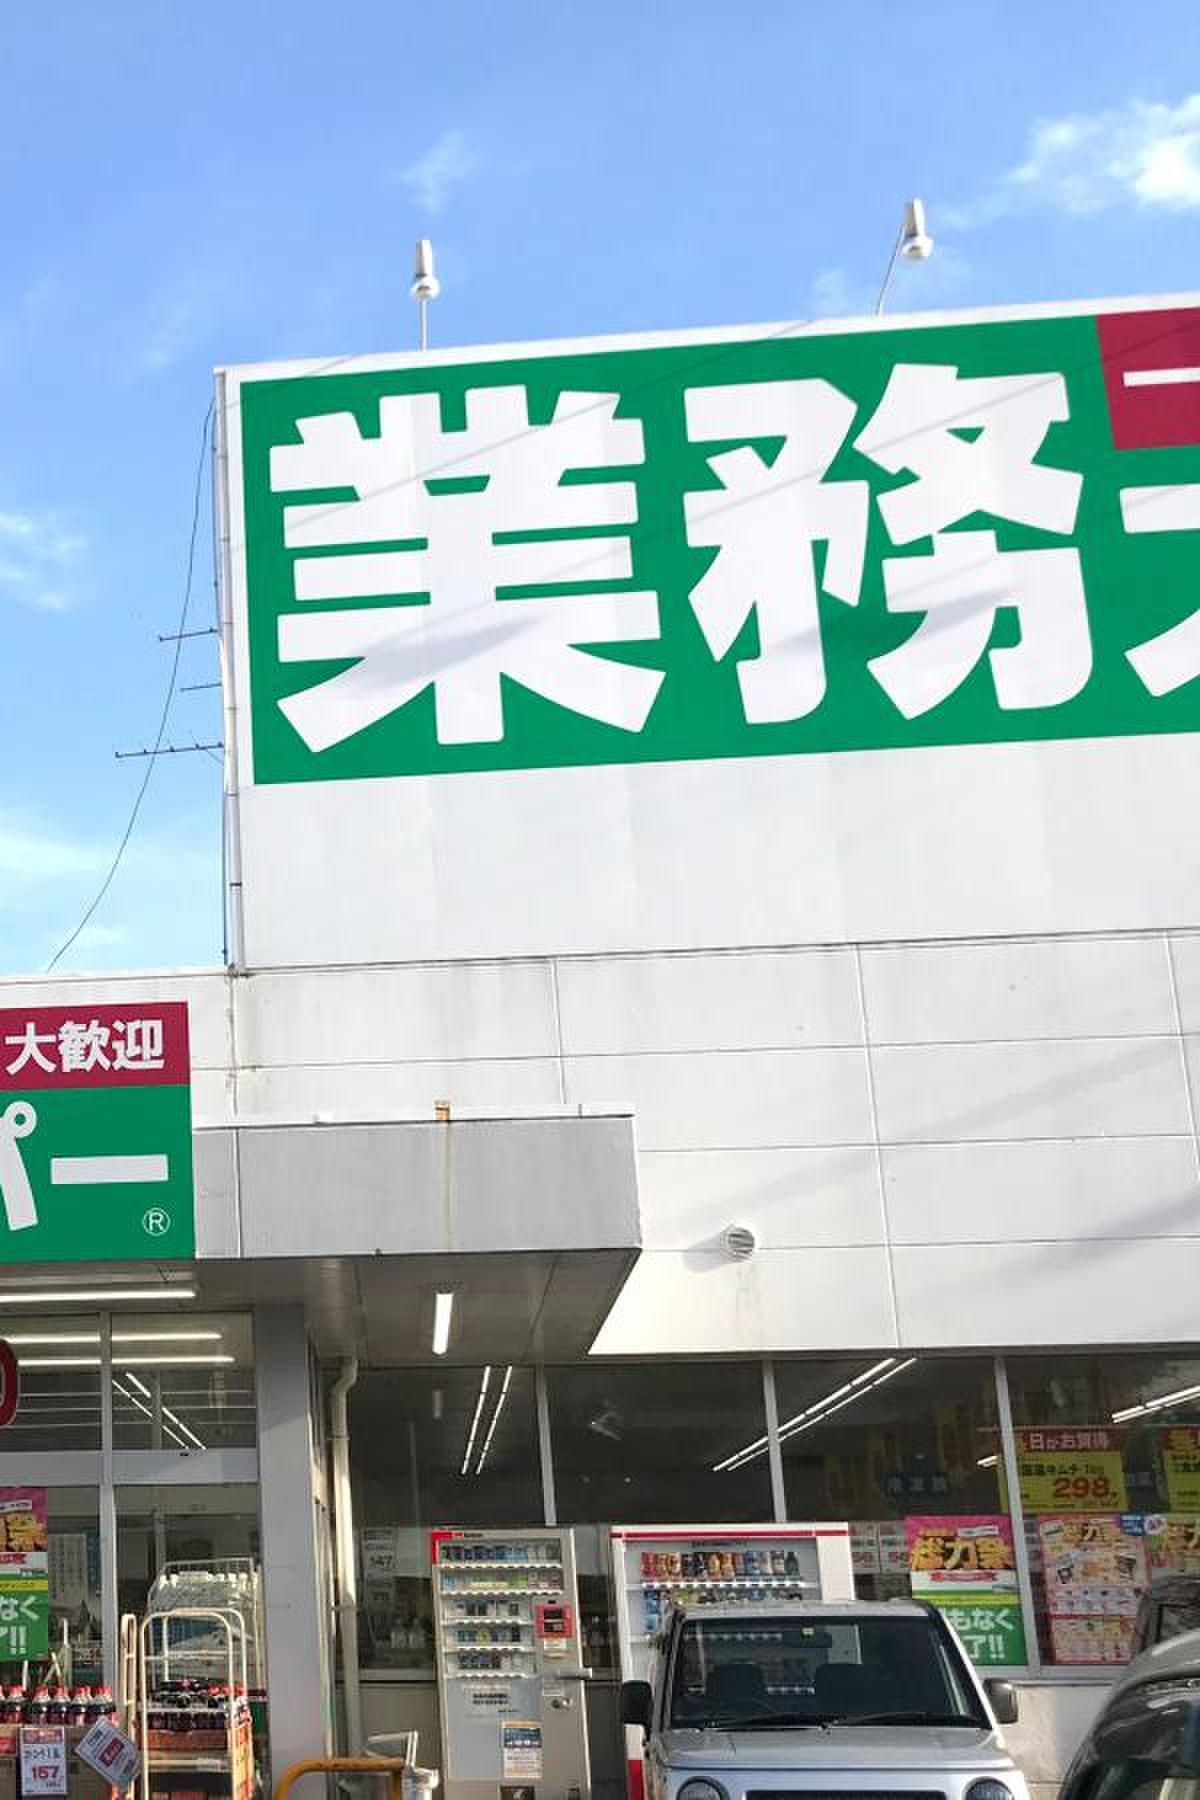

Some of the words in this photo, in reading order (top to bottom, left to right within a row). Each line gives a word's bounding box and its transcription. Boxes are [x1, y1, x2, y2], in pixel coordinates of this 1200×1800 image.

[5, 1018, 165, 1075] 大歓迎
[941, 1607, 1014, 1631] もなく
